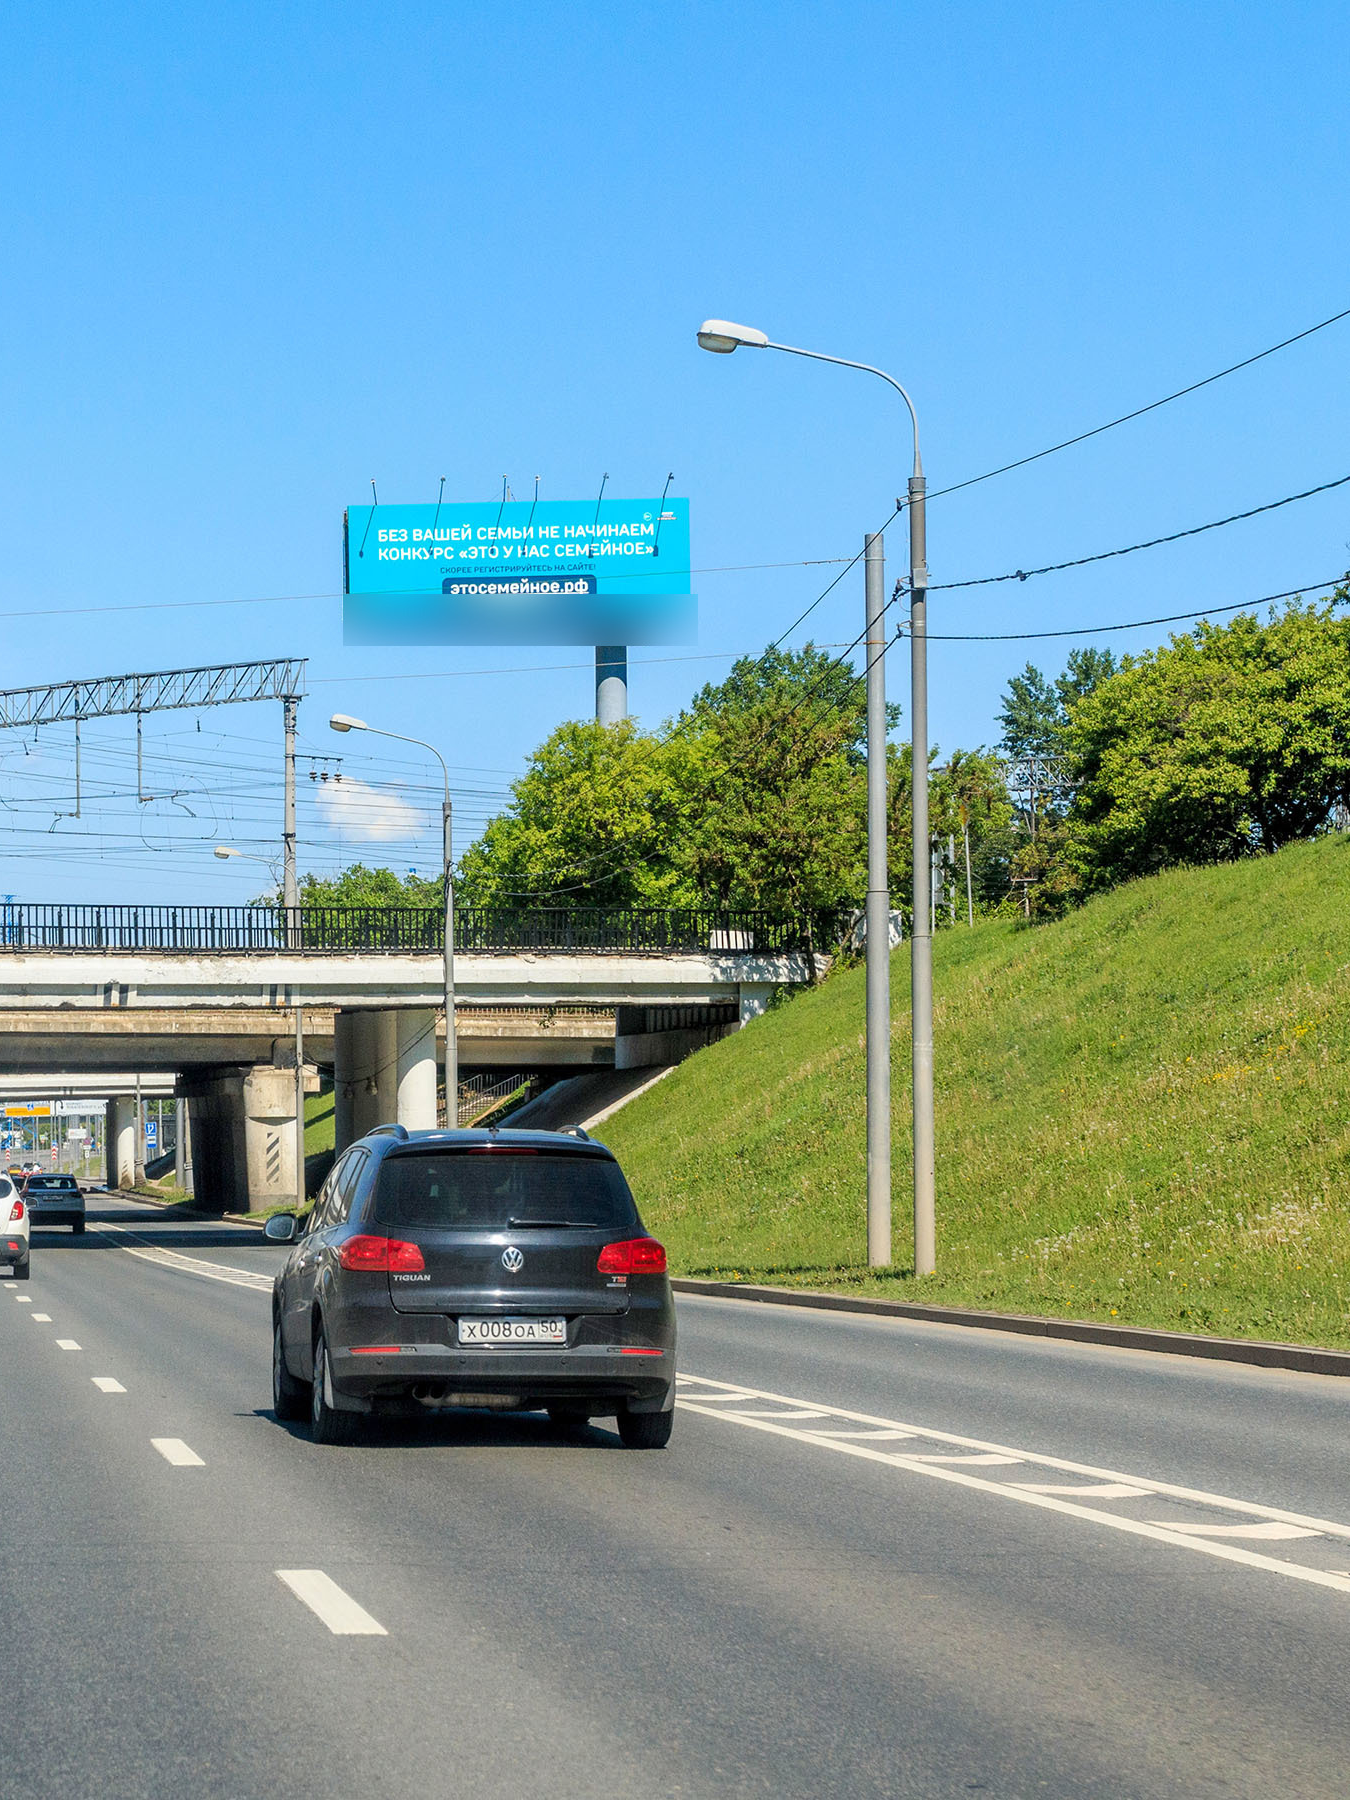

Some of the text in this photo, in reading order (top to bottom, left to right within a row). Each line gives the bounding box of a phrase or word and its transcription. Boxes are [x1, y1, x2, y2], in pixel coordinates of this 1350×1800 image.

[378, 523, 654, 542] БЕЗ ВАШЕЙ СЕМЬИ НЕ НАЧИНАЕМ
[378, 539, 654, 560] КОНКУРС «ЭТО У НАС СЕМЕЙНОЕ»
[440, 566, 472, 574] СКОРЕЕ
[473, 563, 553, 573] РЕГИСТРИРУЙТЕСЬ
[566, 562, 596, 571] САЙТЕ!
[450, 578, 589, 594] этосемейное.рф
